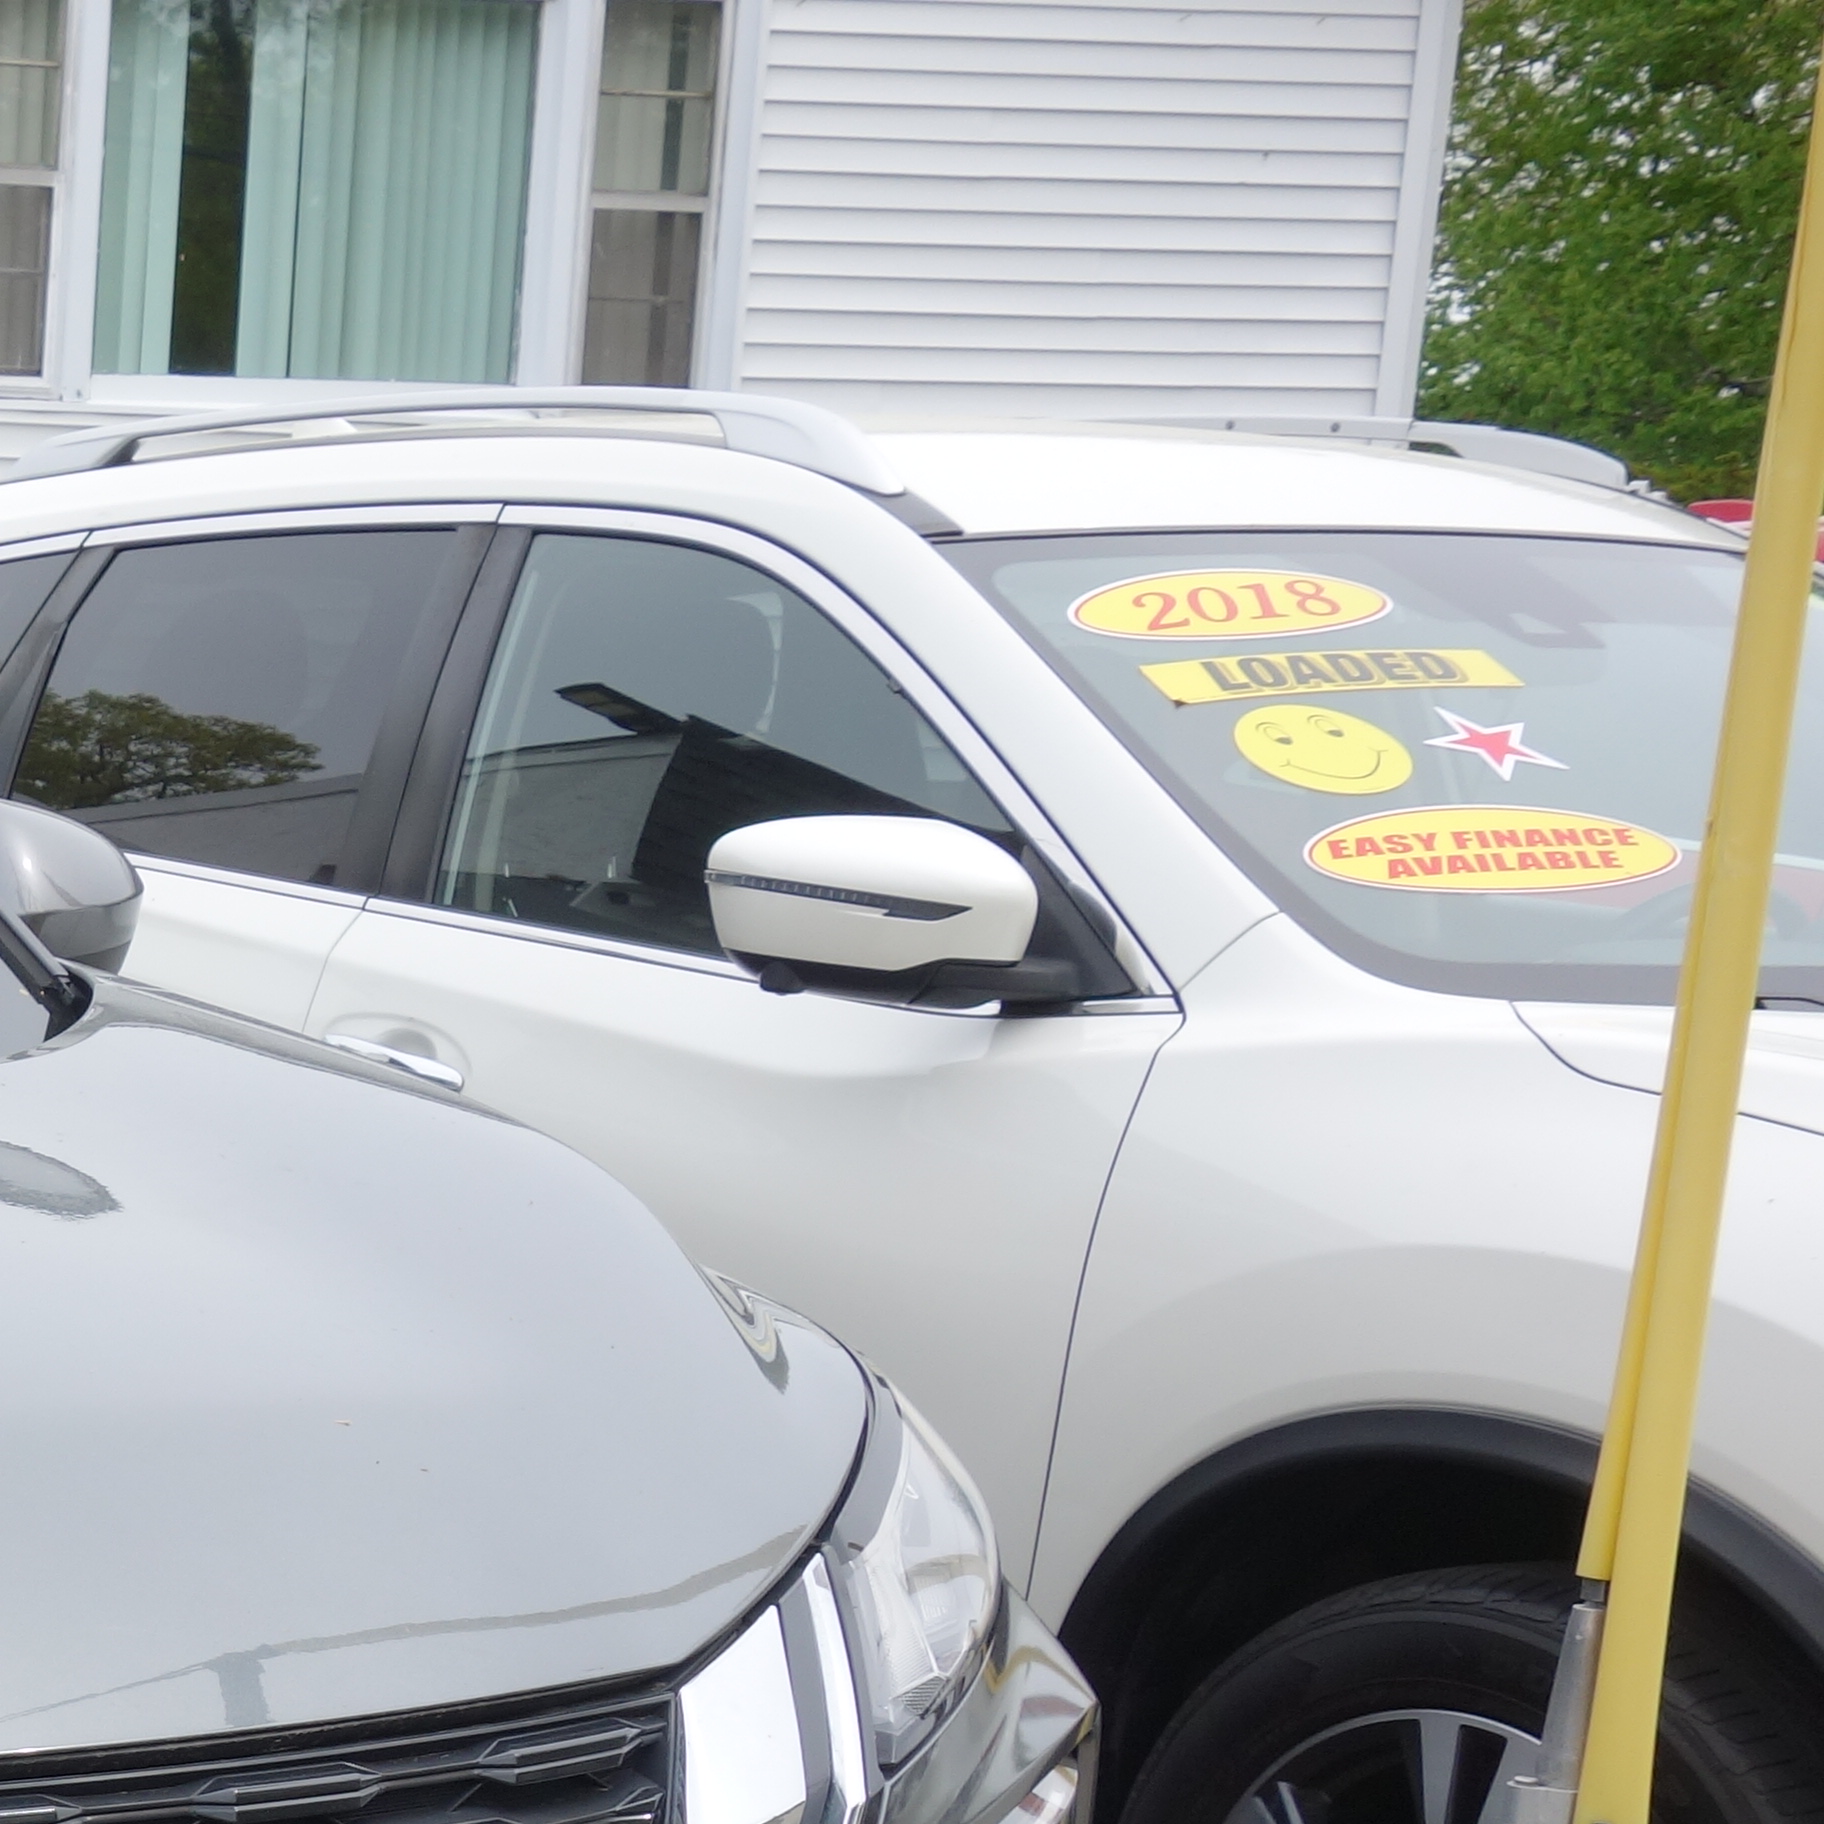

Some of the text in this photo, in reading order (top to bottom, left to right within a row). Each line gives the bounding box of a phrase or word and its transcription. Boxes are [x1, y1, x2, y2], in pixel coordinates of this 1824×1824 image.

[1132, 579, 1342, 633] 2018
[1199, 651, 1468, 695] LOADED
[1327, 826, 1640, 861] EASY FINANCE
[1387, 849, 1624, 880] AVAILABLE
